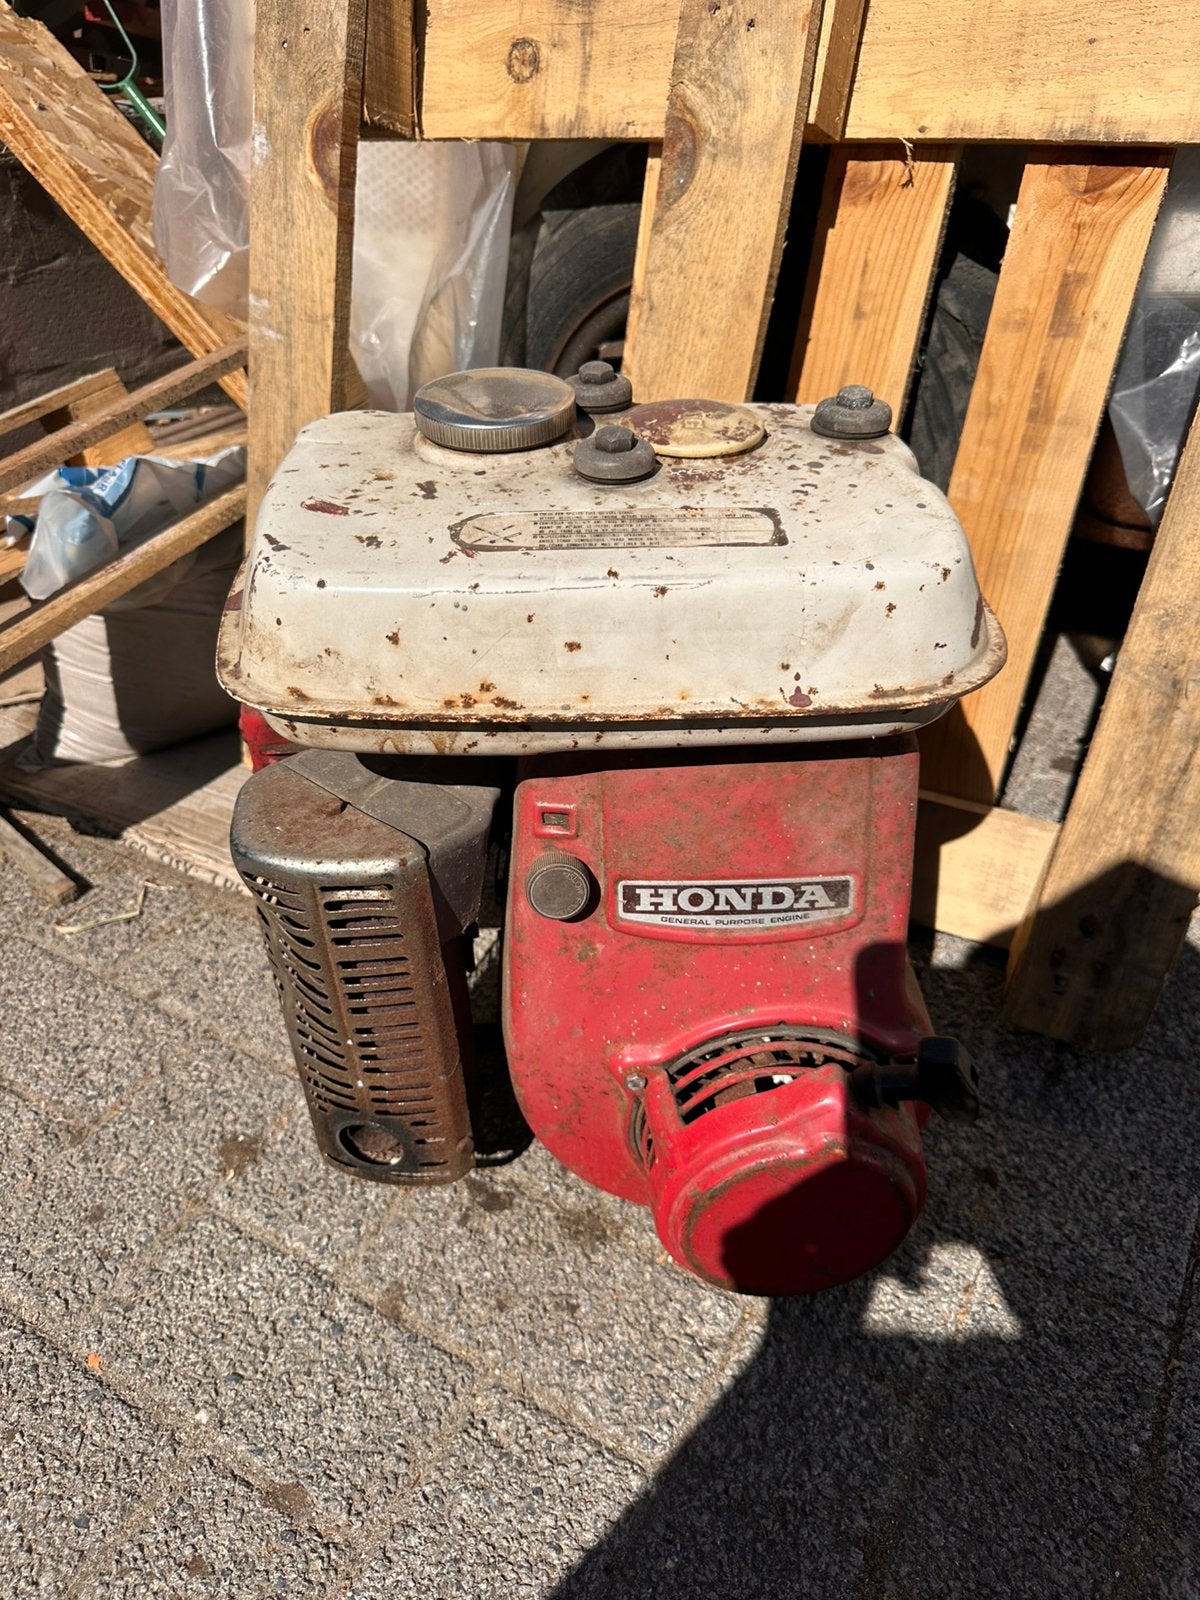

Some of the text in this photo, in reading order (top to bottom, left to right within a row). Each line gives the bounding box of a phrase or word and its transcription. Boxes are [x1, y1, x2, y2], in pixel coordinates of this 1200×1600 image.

[635, 885, 835, 912] HONDA
[660, 912, 810, 926] GENERAL PURPOSE ENGINE
